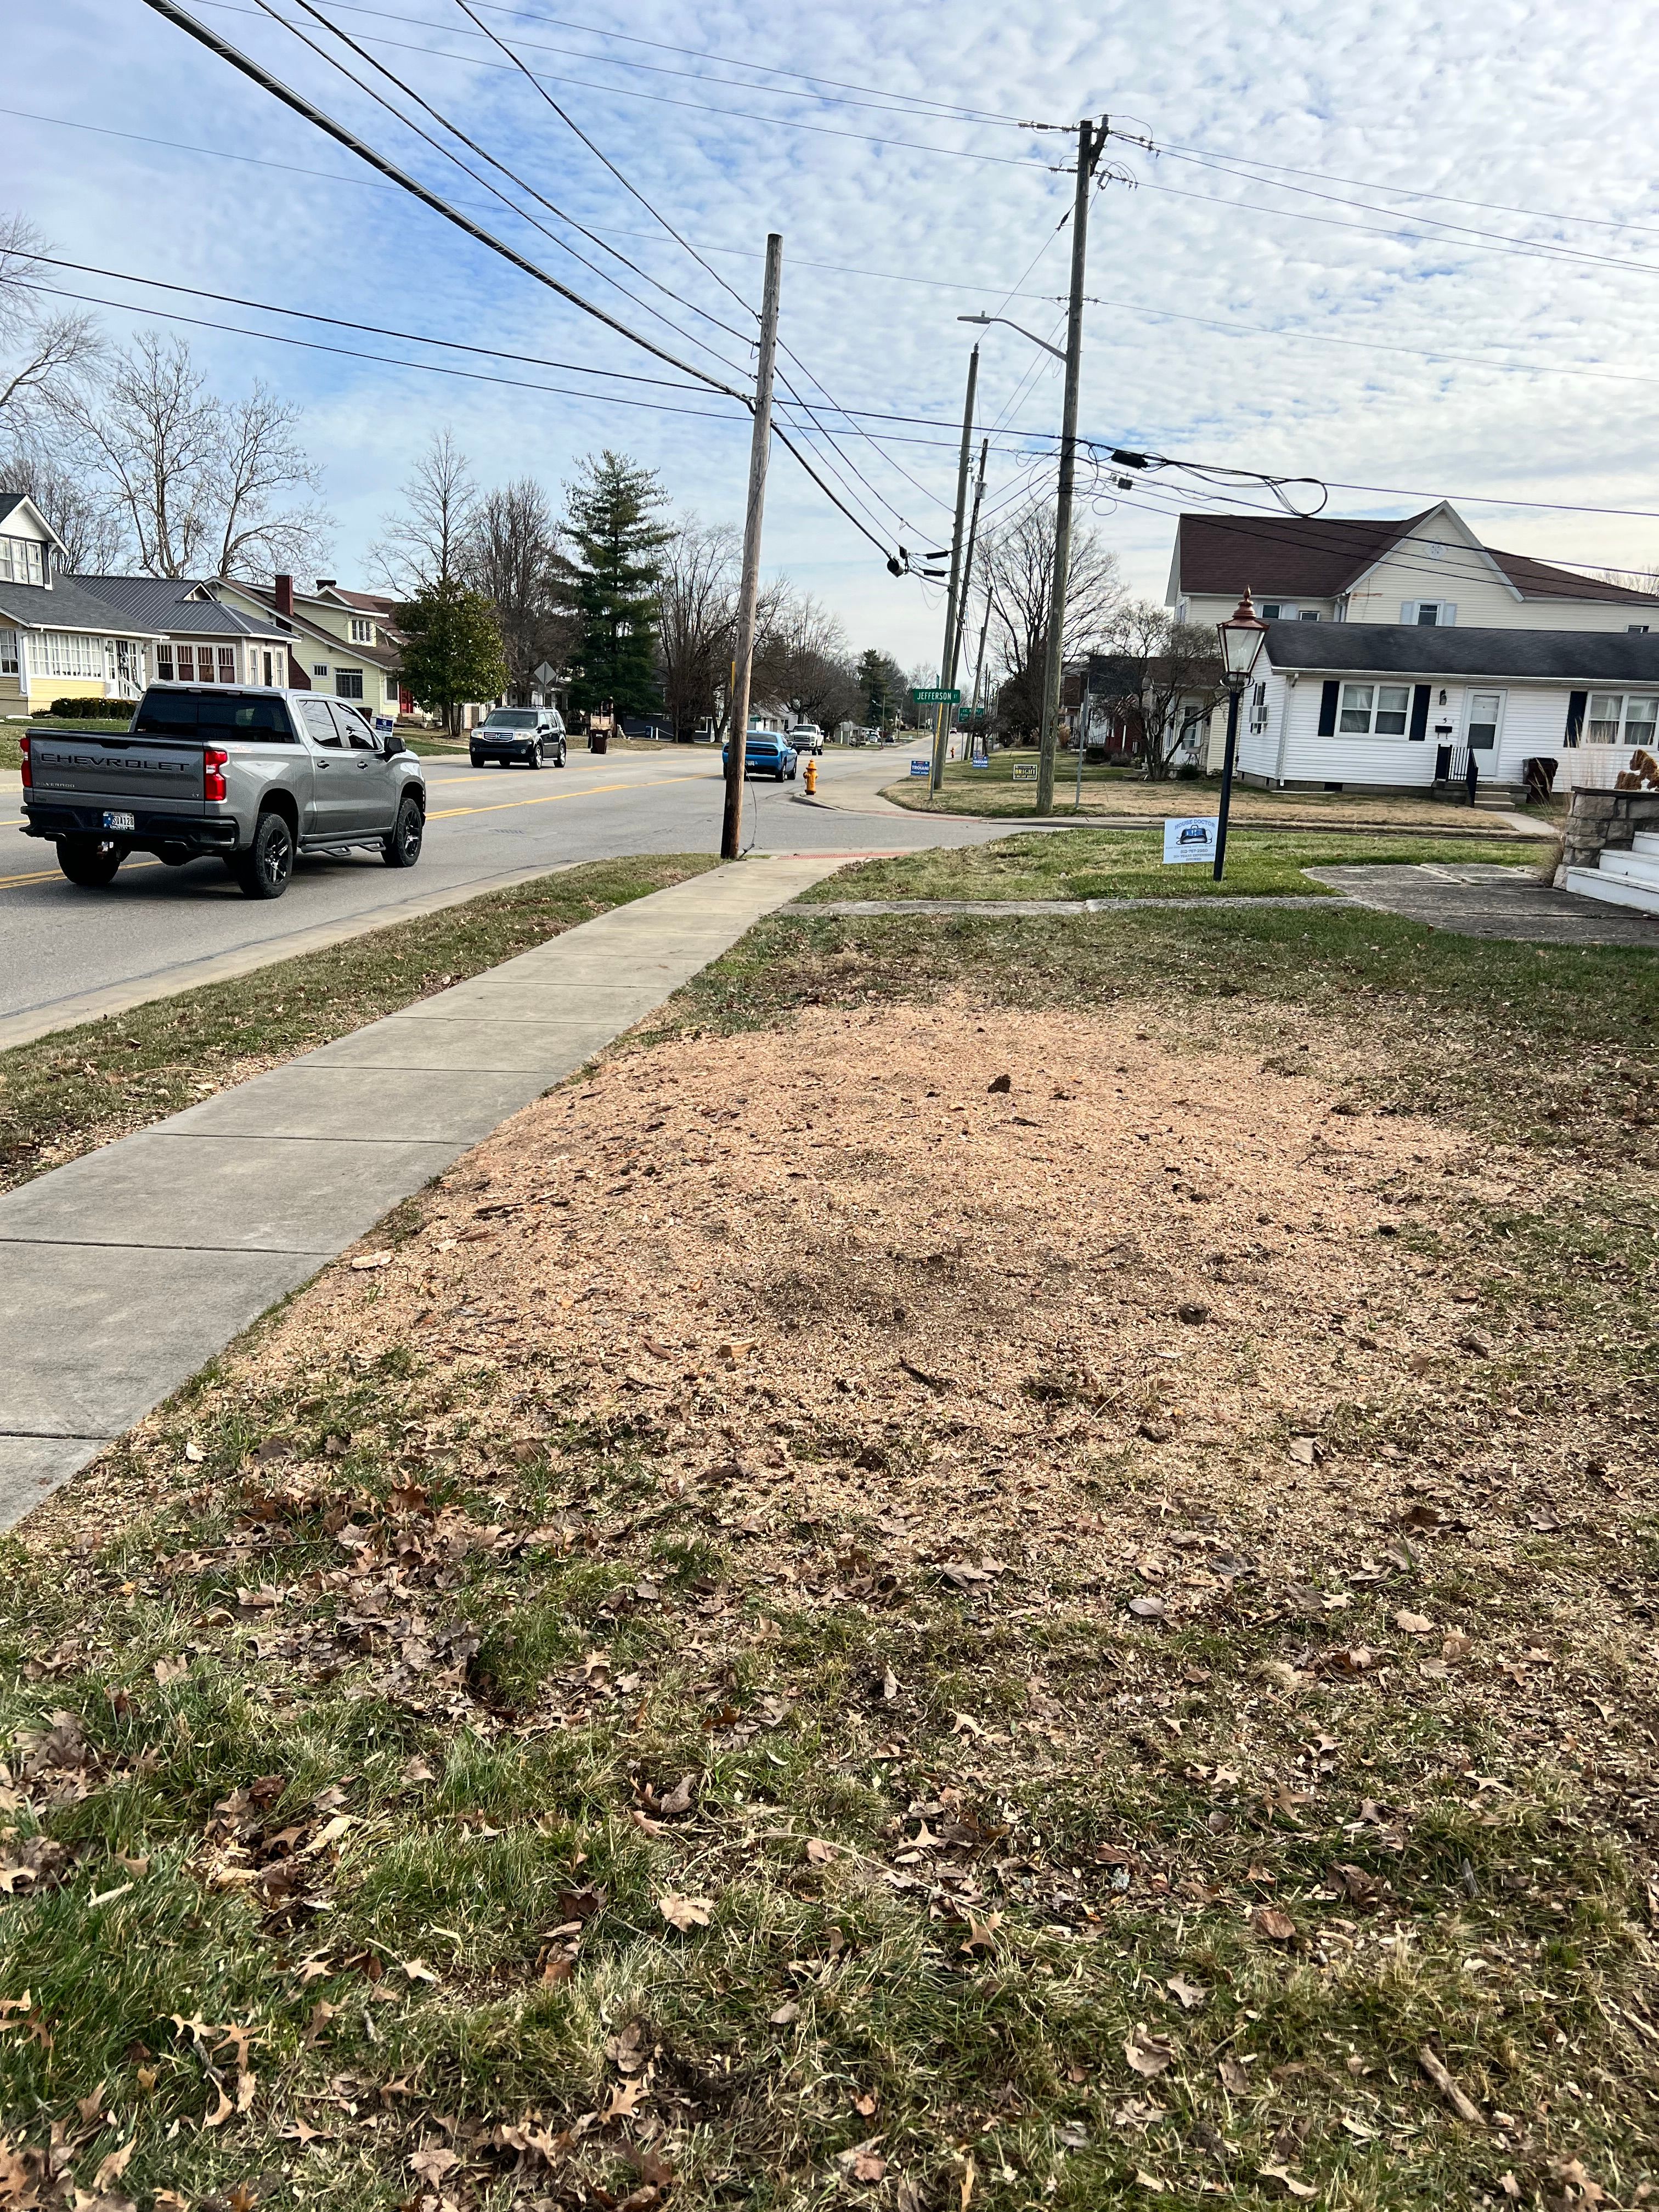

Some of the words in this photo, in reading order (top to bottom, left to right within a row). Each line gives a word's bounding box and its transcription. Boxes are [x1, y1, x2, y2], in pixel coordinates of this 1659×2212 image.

[917, 692, 952, 701] JEFFERSON
[41, 753, 190, 771] CHEVROLET
[1175, 820, 1193, 830] HOUSE
[1194, 819, 1215, 828] DOCTOR
